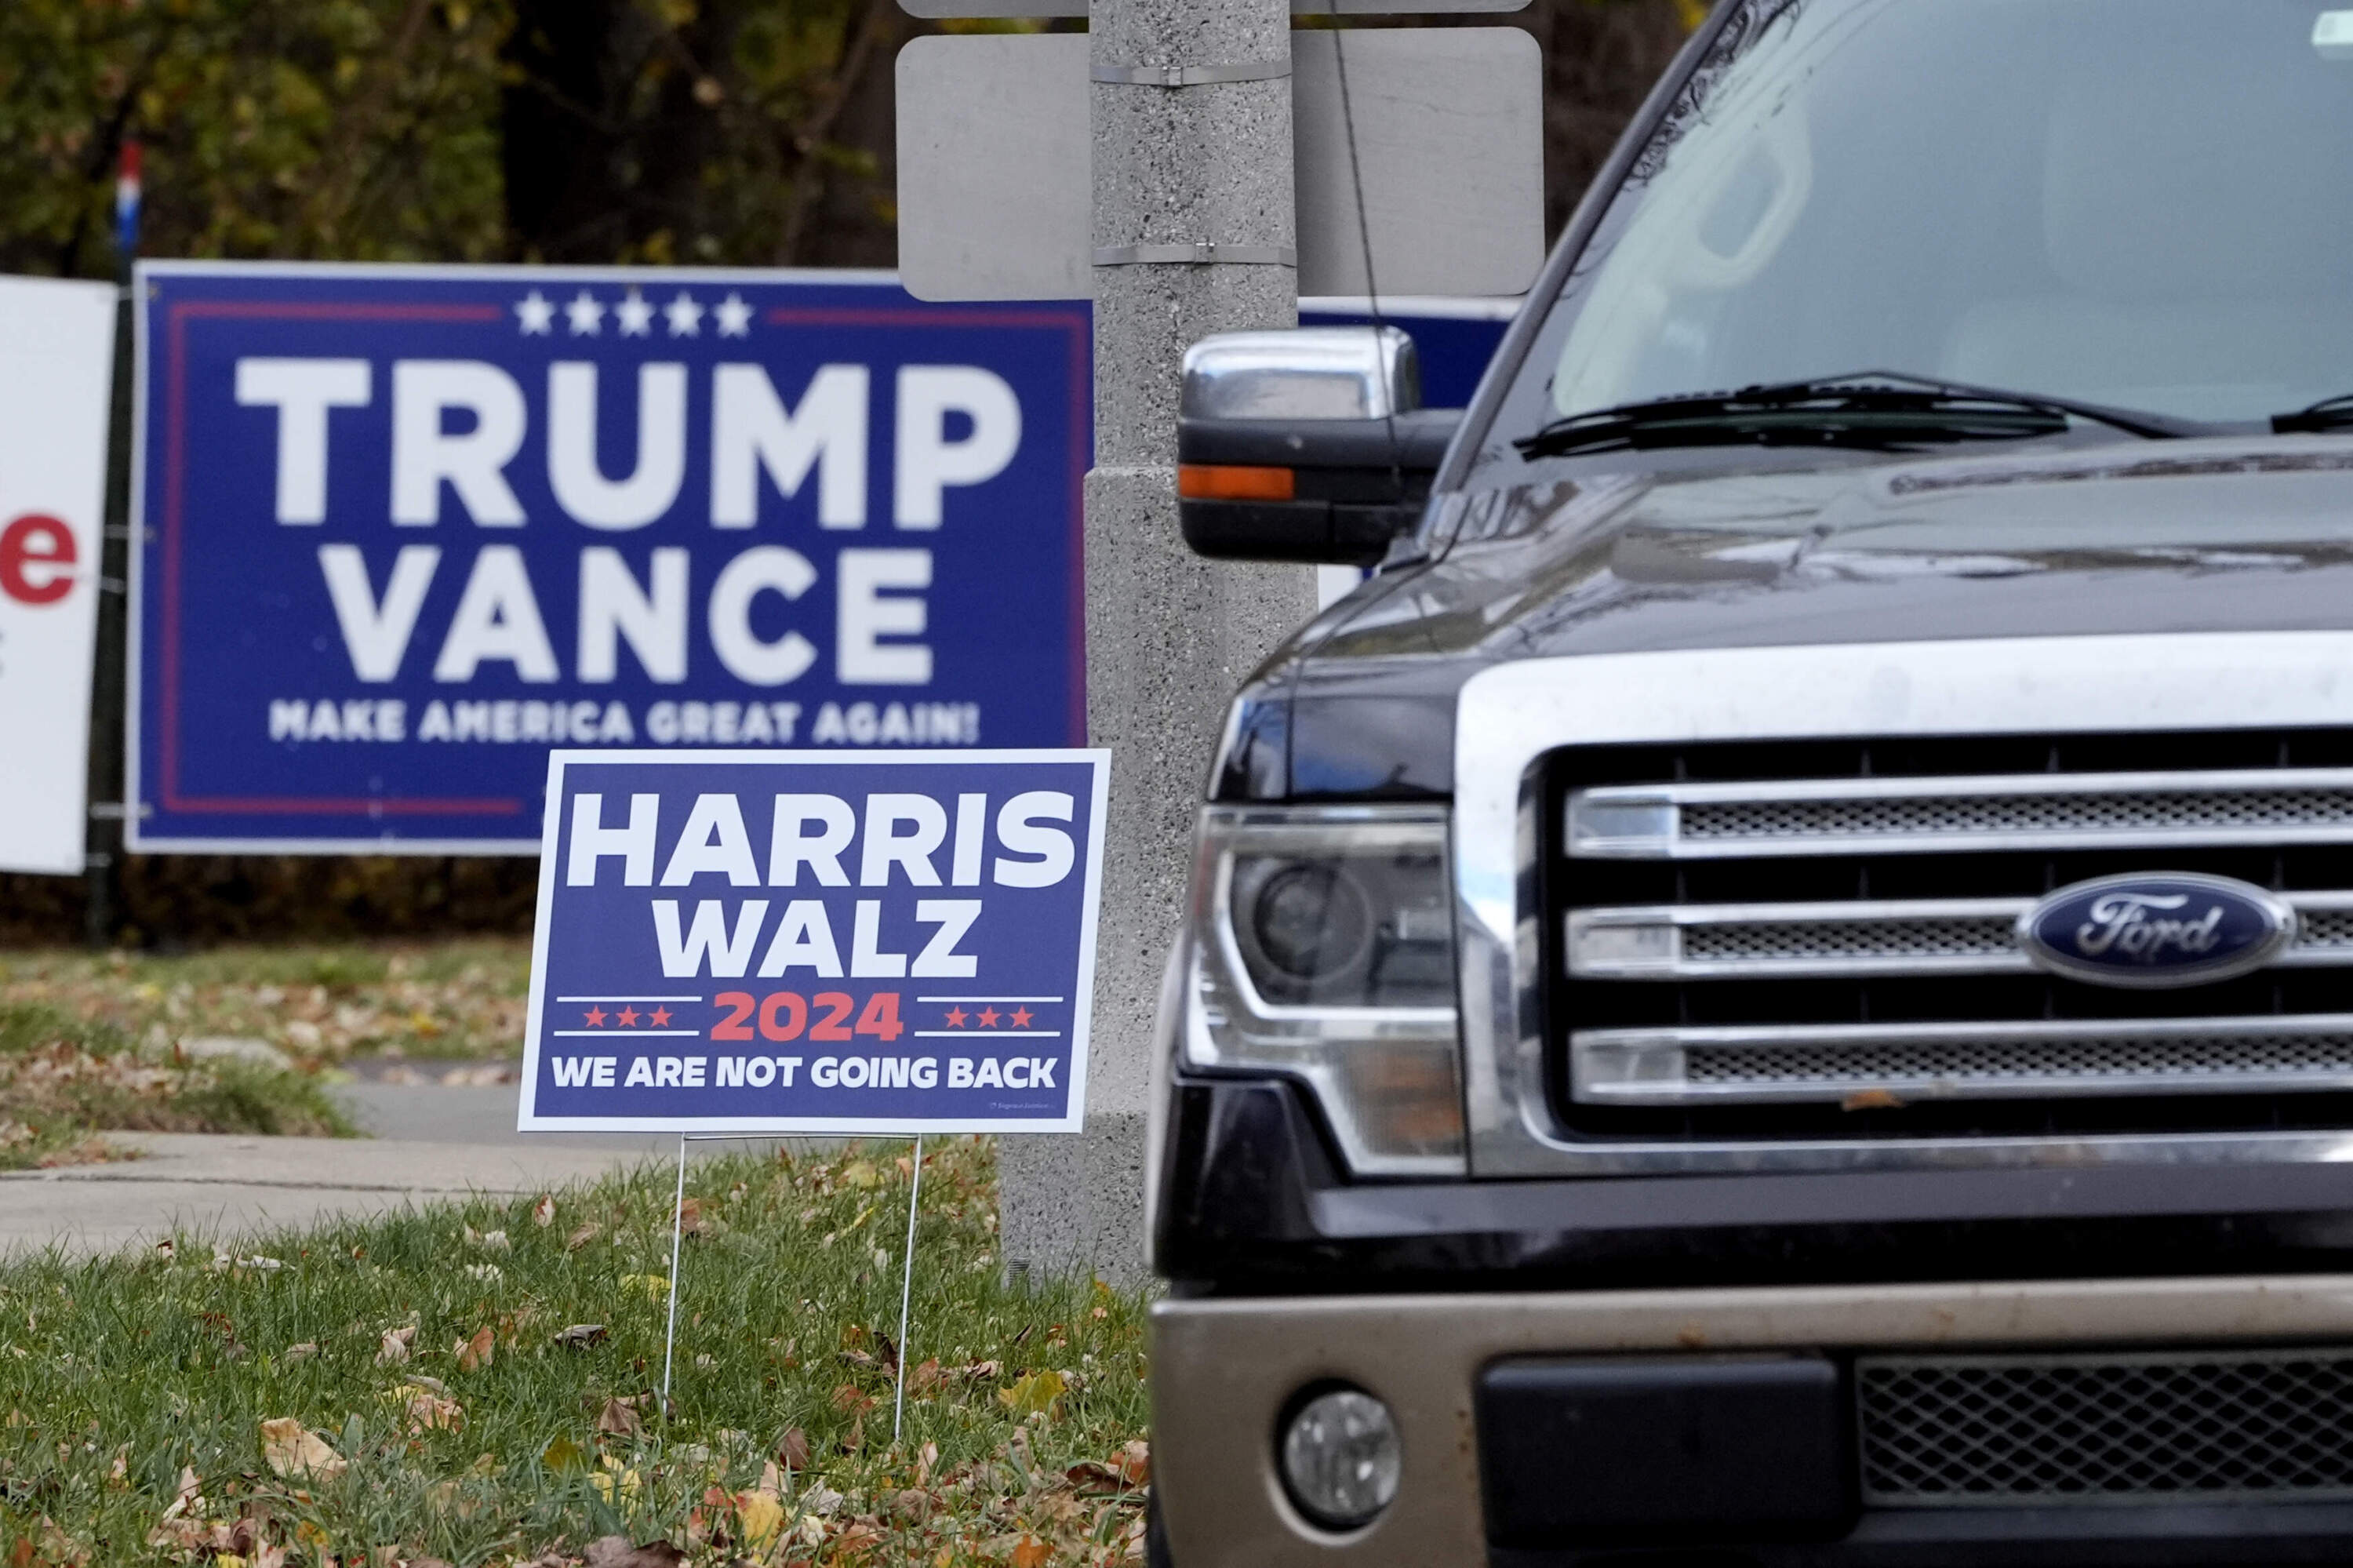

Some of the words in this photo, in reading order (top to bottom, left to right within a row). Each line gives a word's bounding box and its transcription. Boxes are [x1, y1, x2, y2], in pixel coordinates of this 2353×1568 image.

[235, 358, 1021, 529] TRUMP
[319, 544, 933, 685] VANCE
[269, 700, 406, 742] MAKE
[418, 700, 634, 744] AMERICA
[646, 701, 800, 744] GREAT
[813, 702, 980, 745] AGAIN!
[566, 790, 1075, 889] HARRIS
[651, 899, 983, 979] WALZ
[2078, 892, 2224, 955] Ford
[711, 991, 904, 1042] 2024
[551, 1056, 618, 1089] WE
[624, 1056, 707, 1089] ARE
[715, 1056, 803, 1089] NOT
[810, 1056, 939, 1090] GOING
[947, 1057, 1058, 1090] BACK
